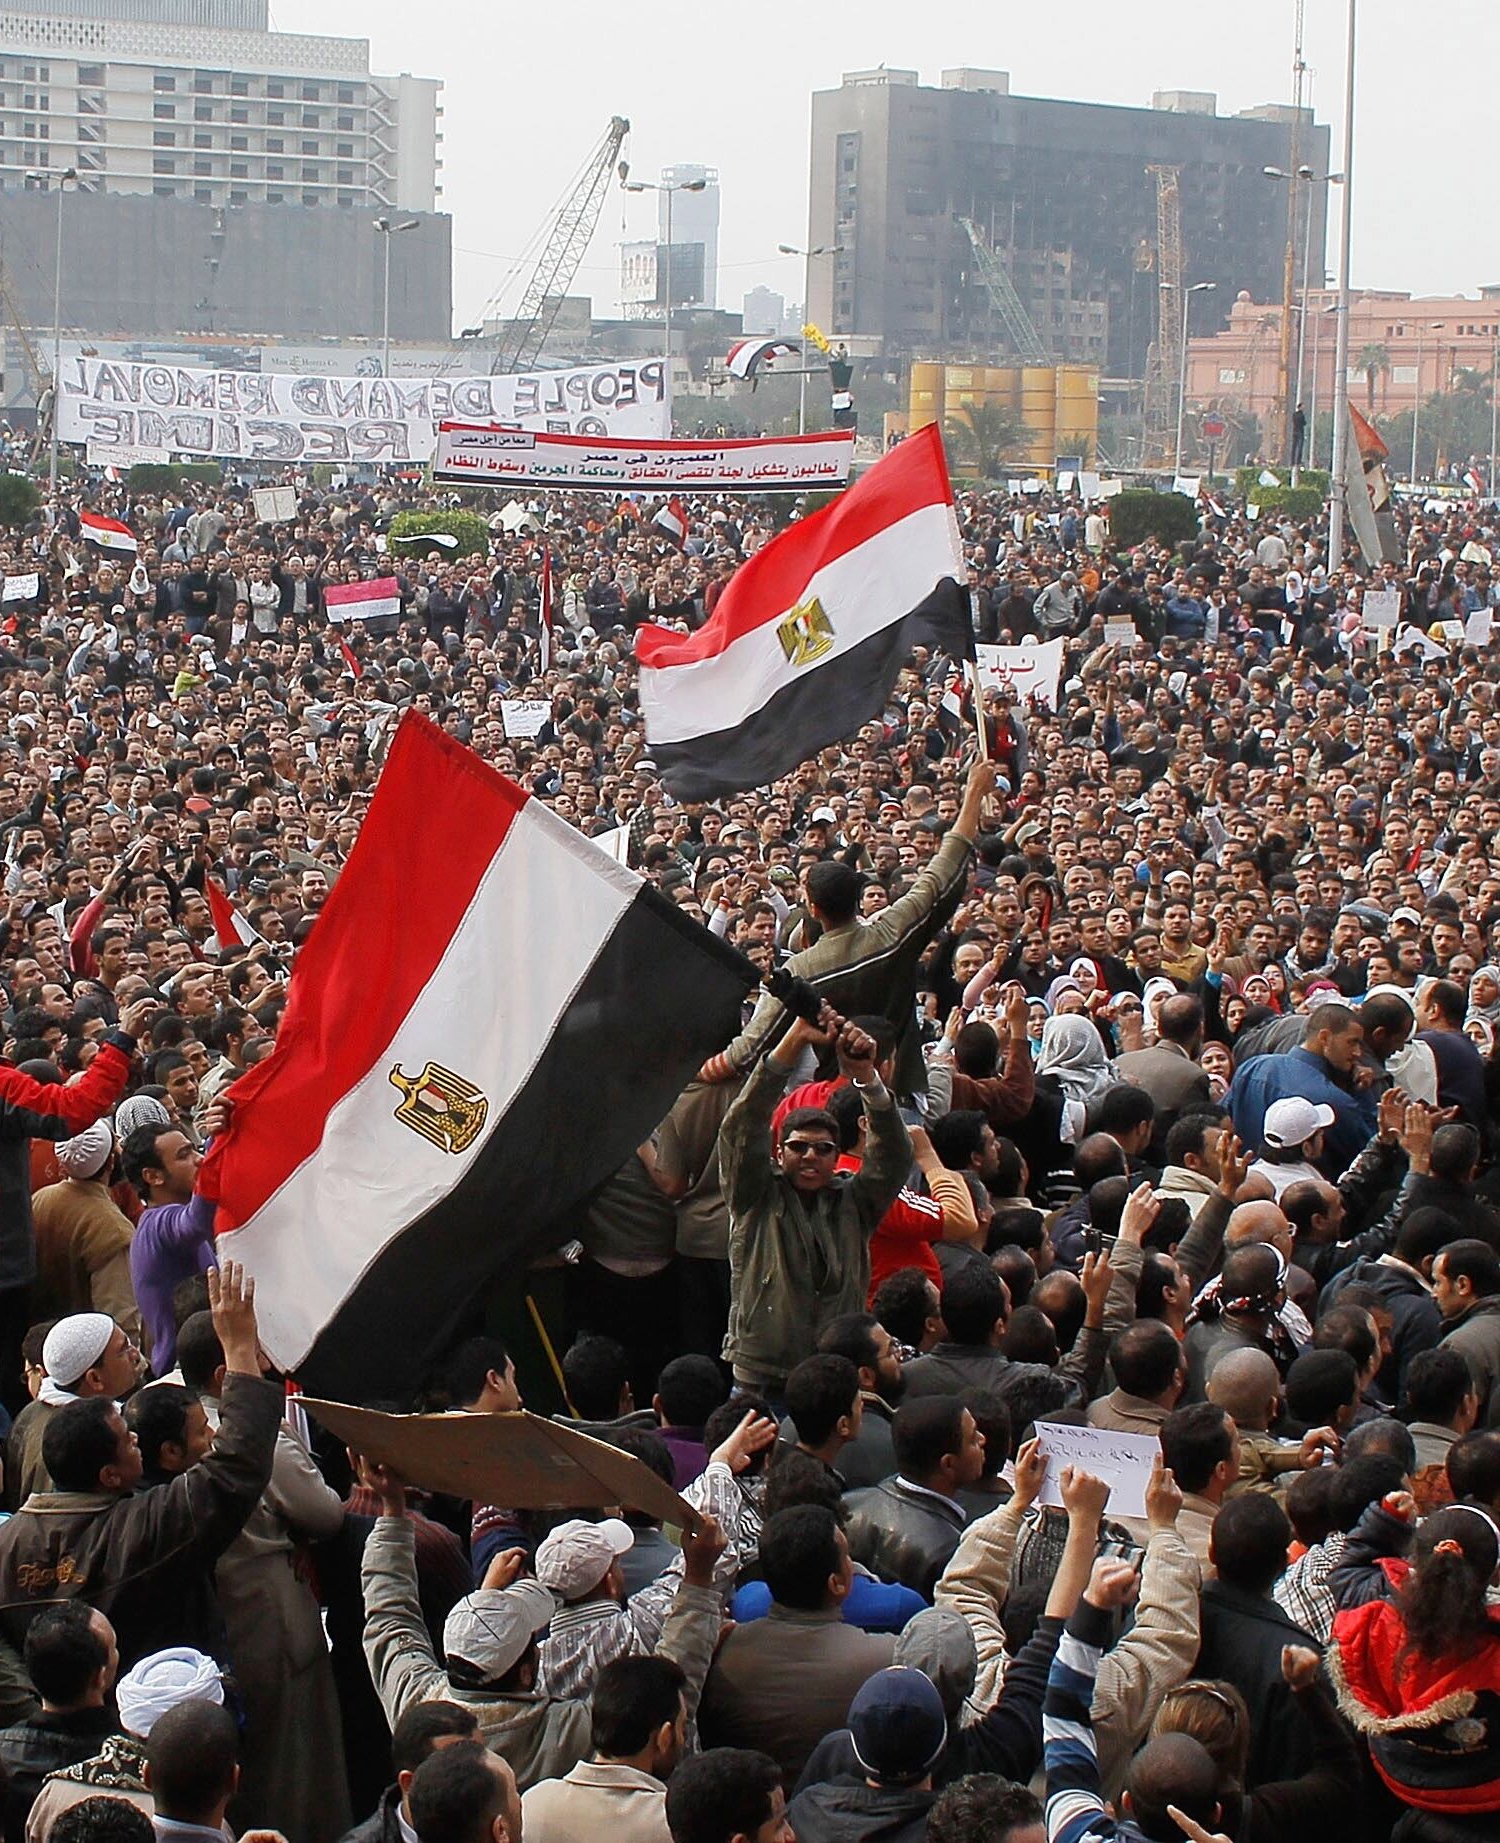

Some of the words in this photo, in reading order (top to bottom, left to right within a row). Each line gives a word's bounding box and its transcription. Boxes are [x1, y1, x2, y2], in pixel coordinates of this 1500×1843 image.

[445, 454, 483, 469] النظام
[582, 453, 618, 464] مصر
[487, 458, 525, 475] وسقوط
[529, 461, 574, 476] المجرمين
[579, 465, 625, 478] ومحاكمة
[676, 466, 714, 480] لتقصى
[718, 466, 743, 478] لجنة
[747, 461, 789, 479] بتشكيل
[629, 468, 672, 480] الحقائق
[989, 653, 1036, 684] نريد
